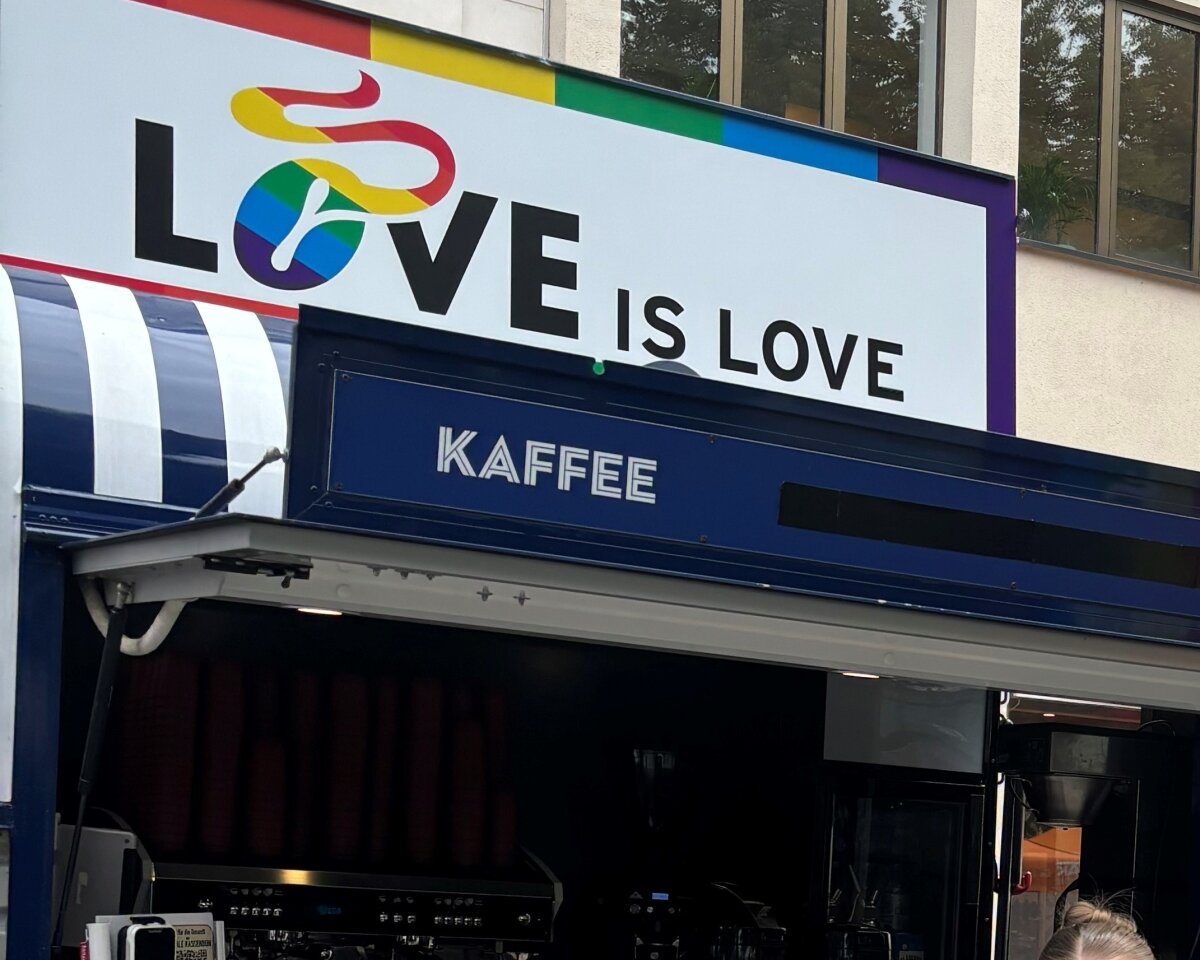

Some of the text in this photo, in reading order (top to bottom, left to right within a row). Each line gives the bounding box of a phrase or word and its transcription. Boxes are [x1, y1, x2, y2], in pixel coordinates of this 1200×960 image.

[134, 70, 905, 402] LOVE IS LOVE
[435, 425, 658, 505] KAFFEE
